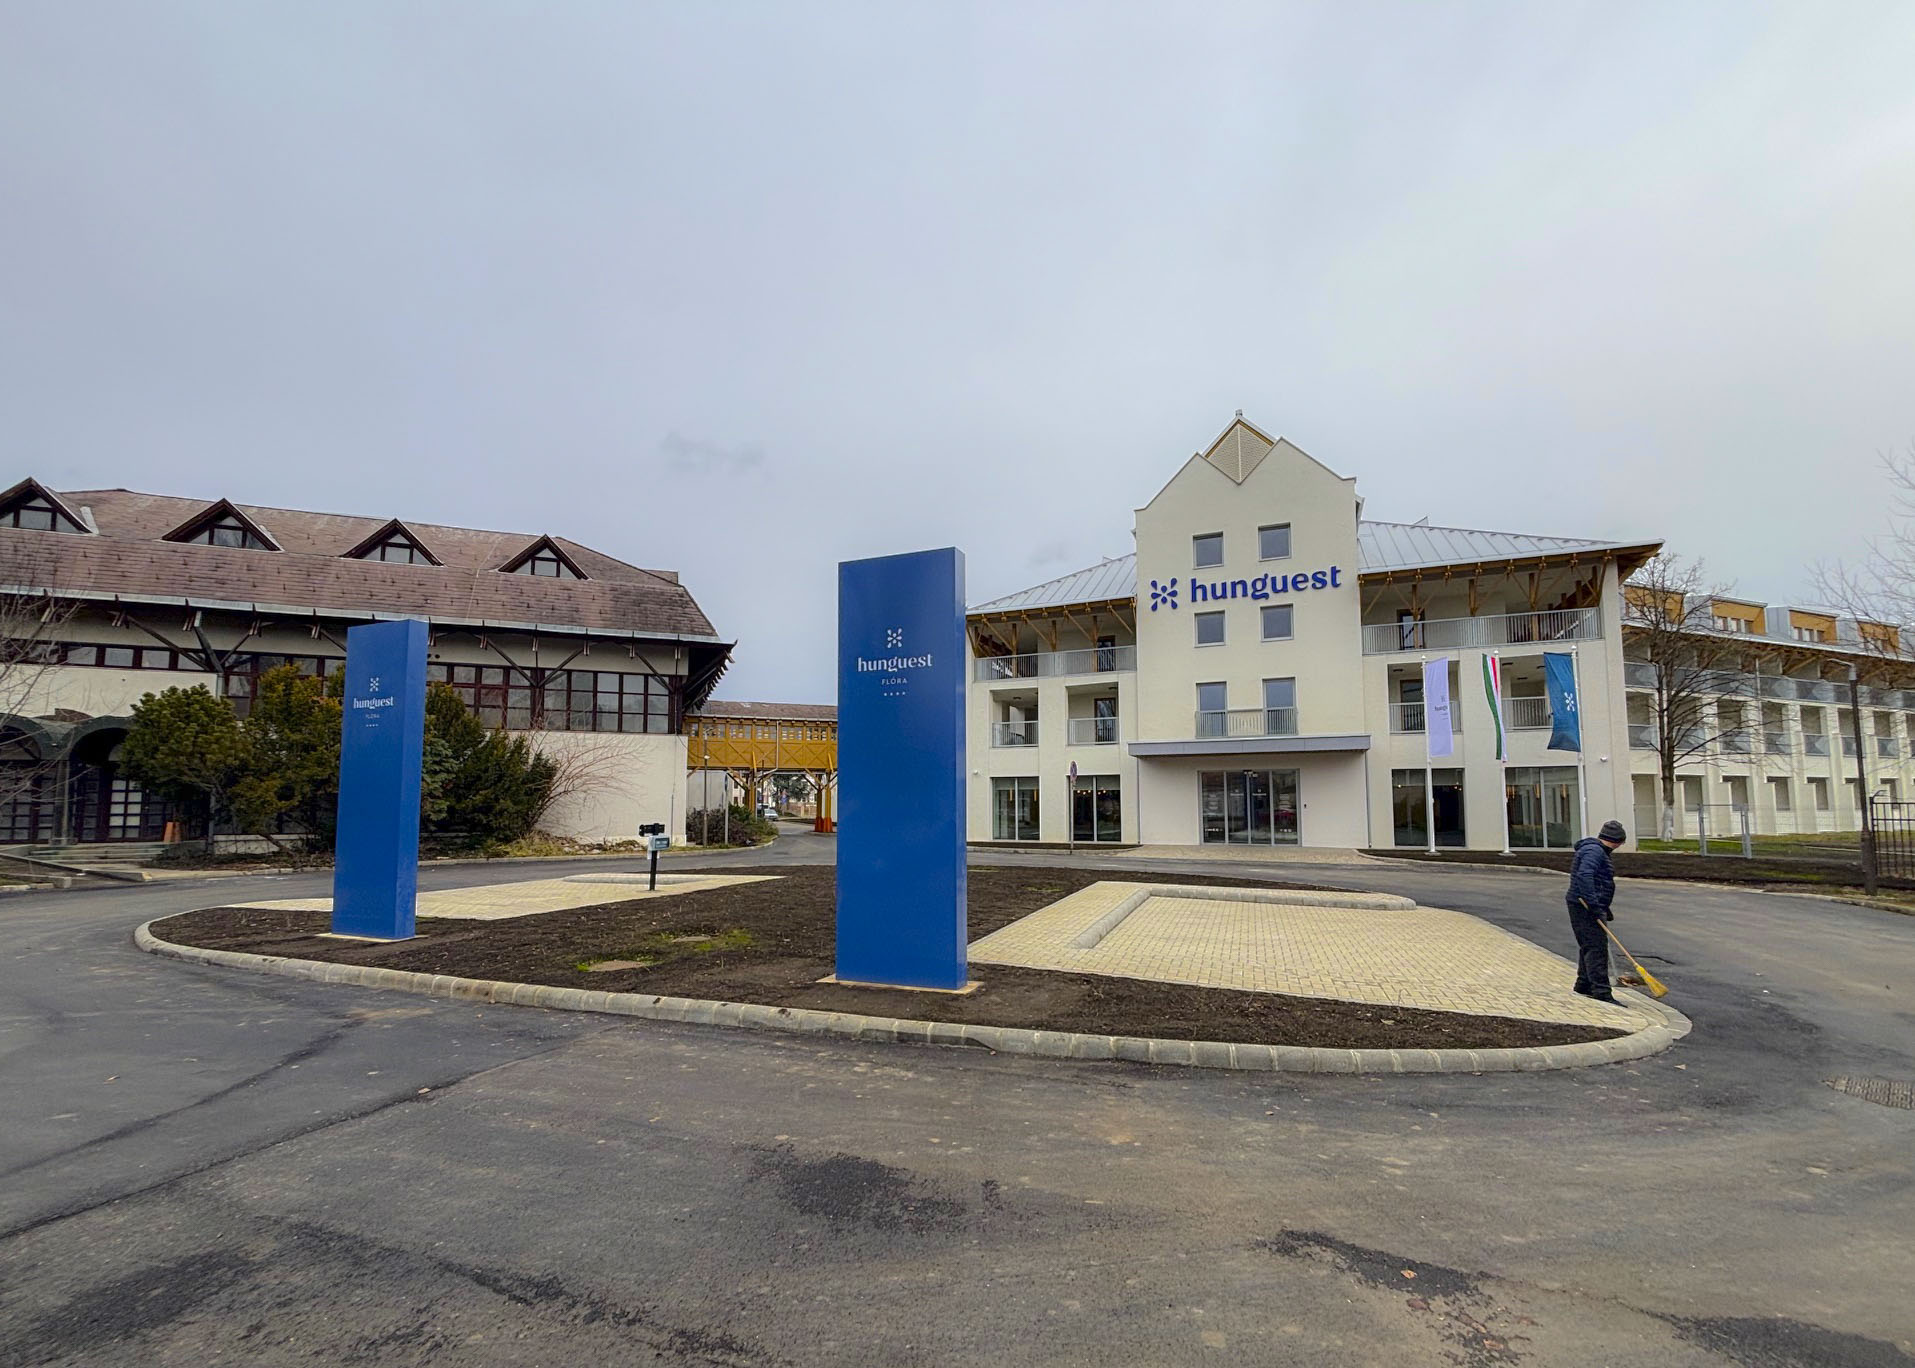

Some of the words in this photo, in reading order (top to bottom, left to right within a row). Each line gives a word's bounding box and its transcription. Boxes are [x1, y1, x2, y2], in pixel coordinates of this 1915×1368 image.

[1190, 565, 1342, 603] hunguest
[857, 653, 933, 672] hunguest
[881, 676, 908, 686] FLÓRA
[353, 696, 394, 710] hunguest
